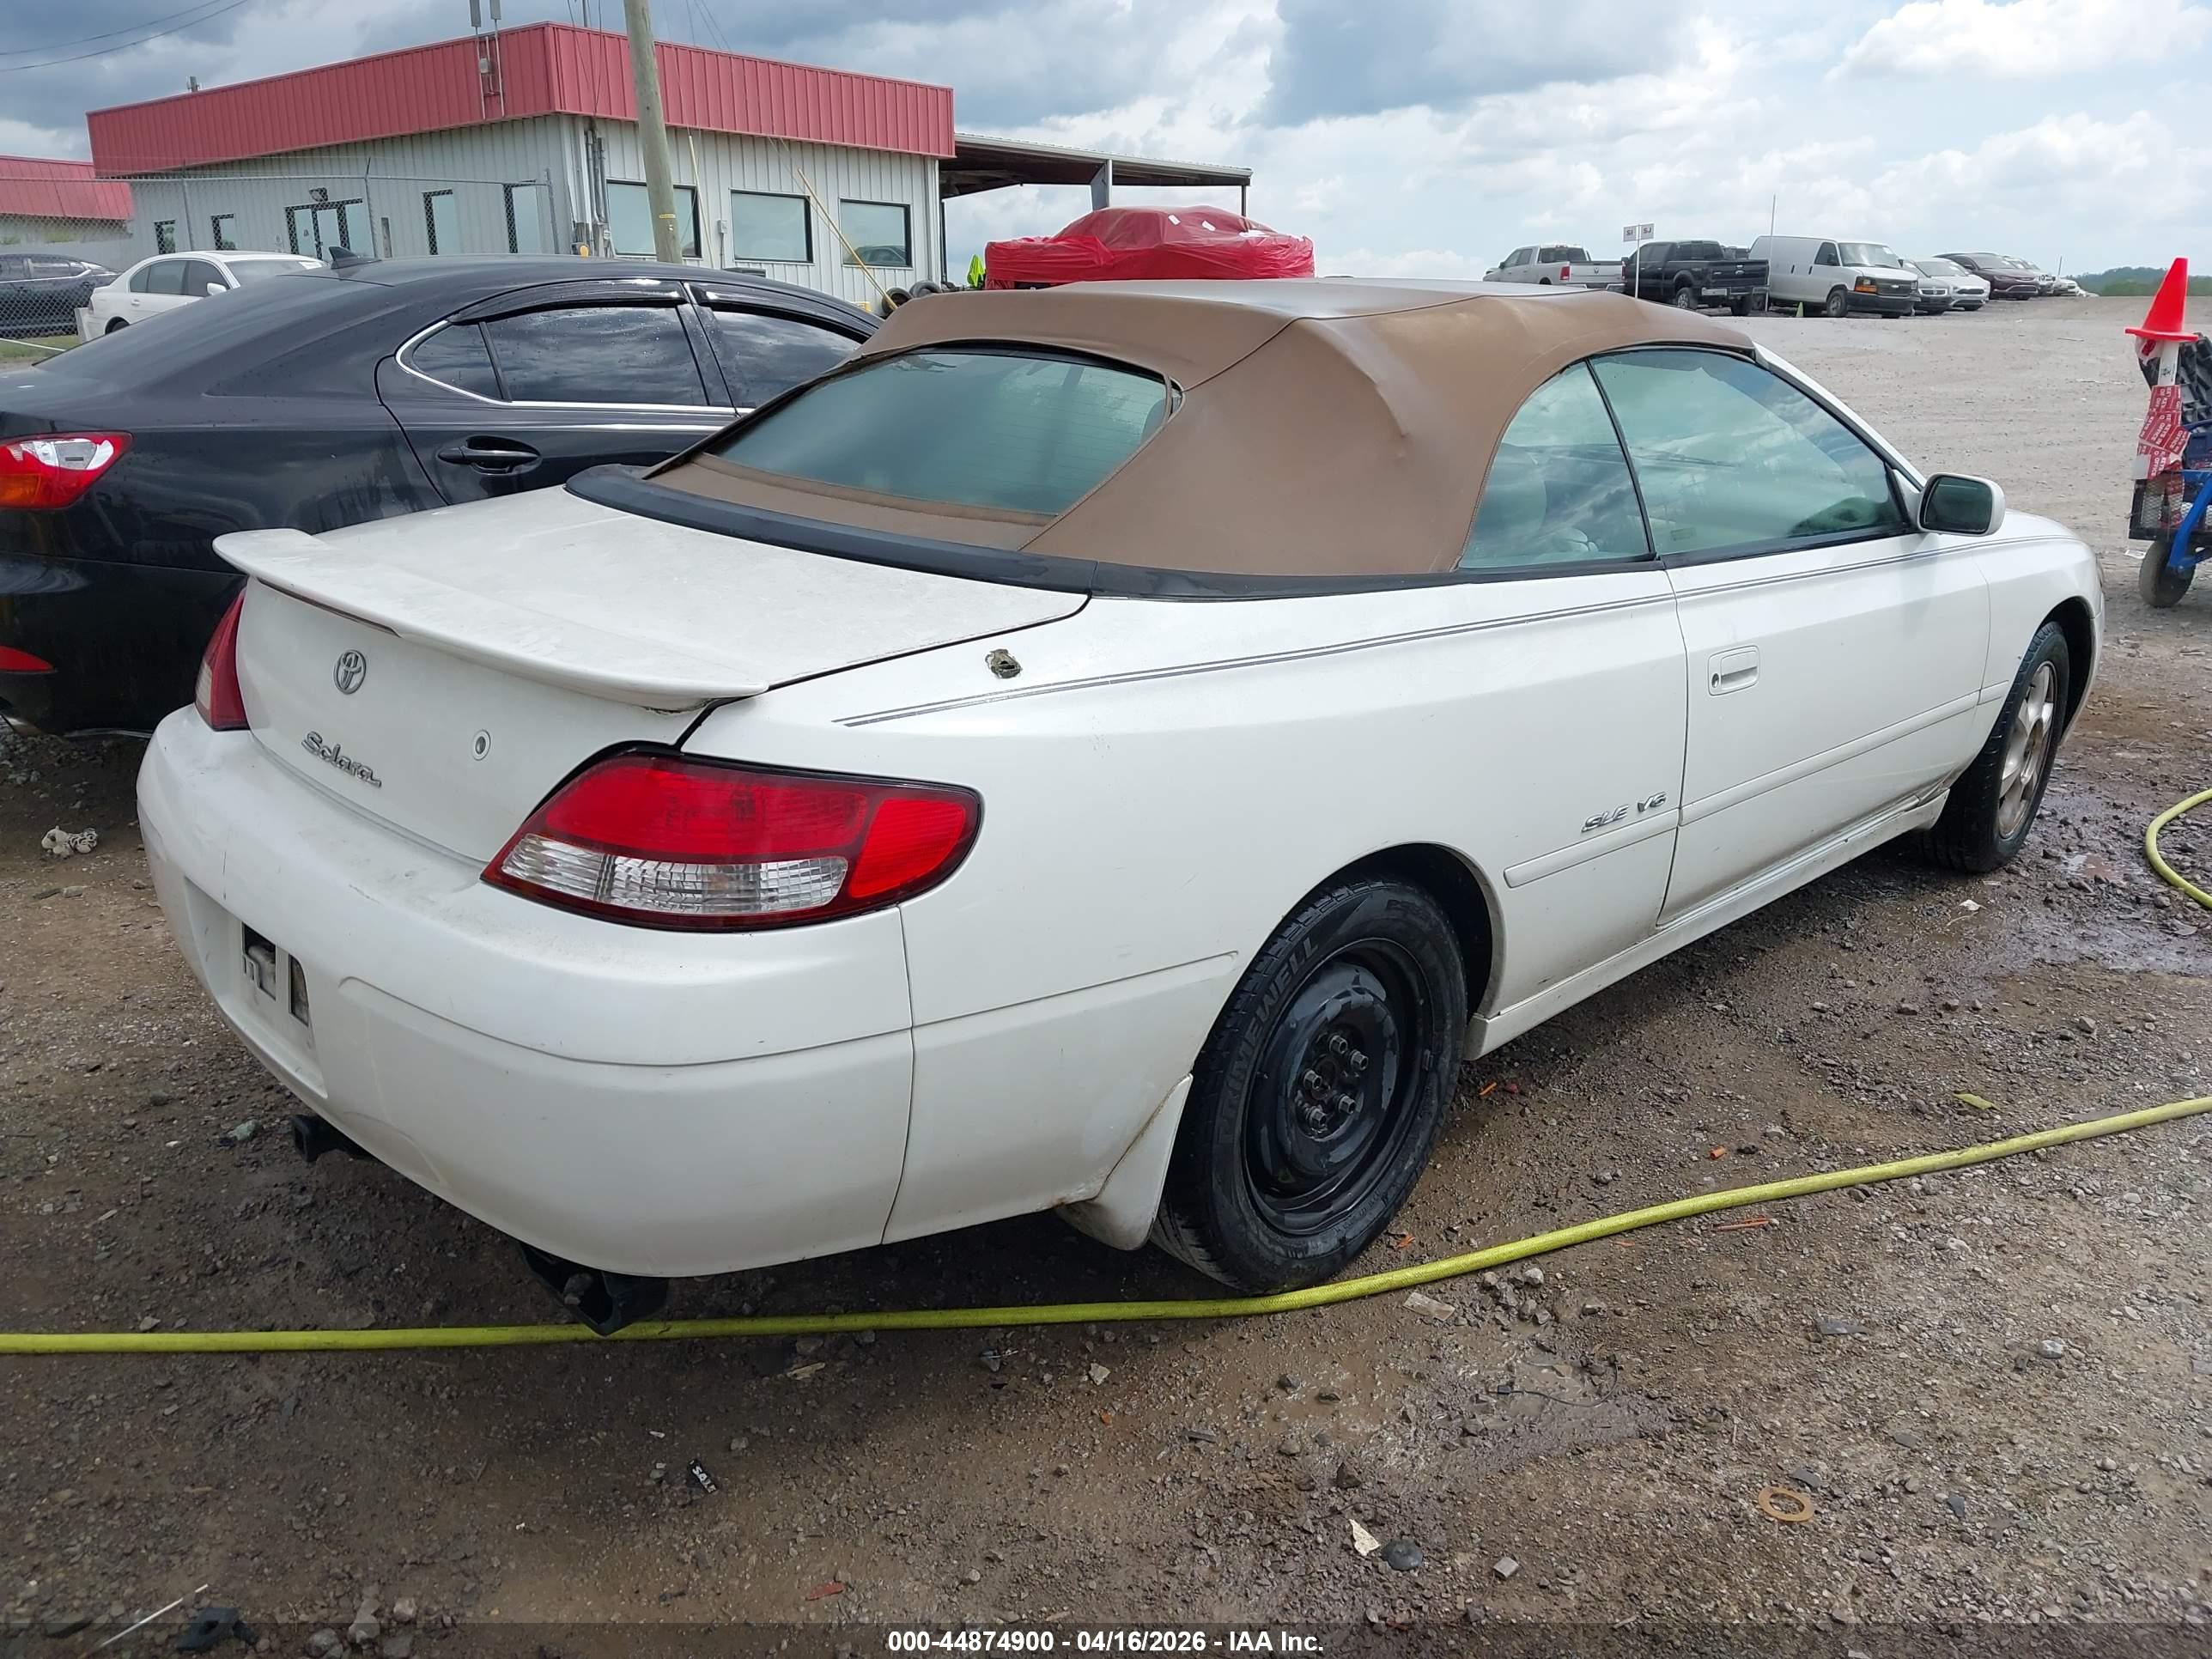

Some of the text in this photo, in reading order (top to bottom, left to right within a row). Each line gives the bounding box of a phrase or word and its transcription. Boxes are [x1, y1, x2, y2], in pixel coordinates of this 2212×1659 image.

[301, 731, 382, 787] Solara
[1581, 791, 1667, 832] SLE V6
